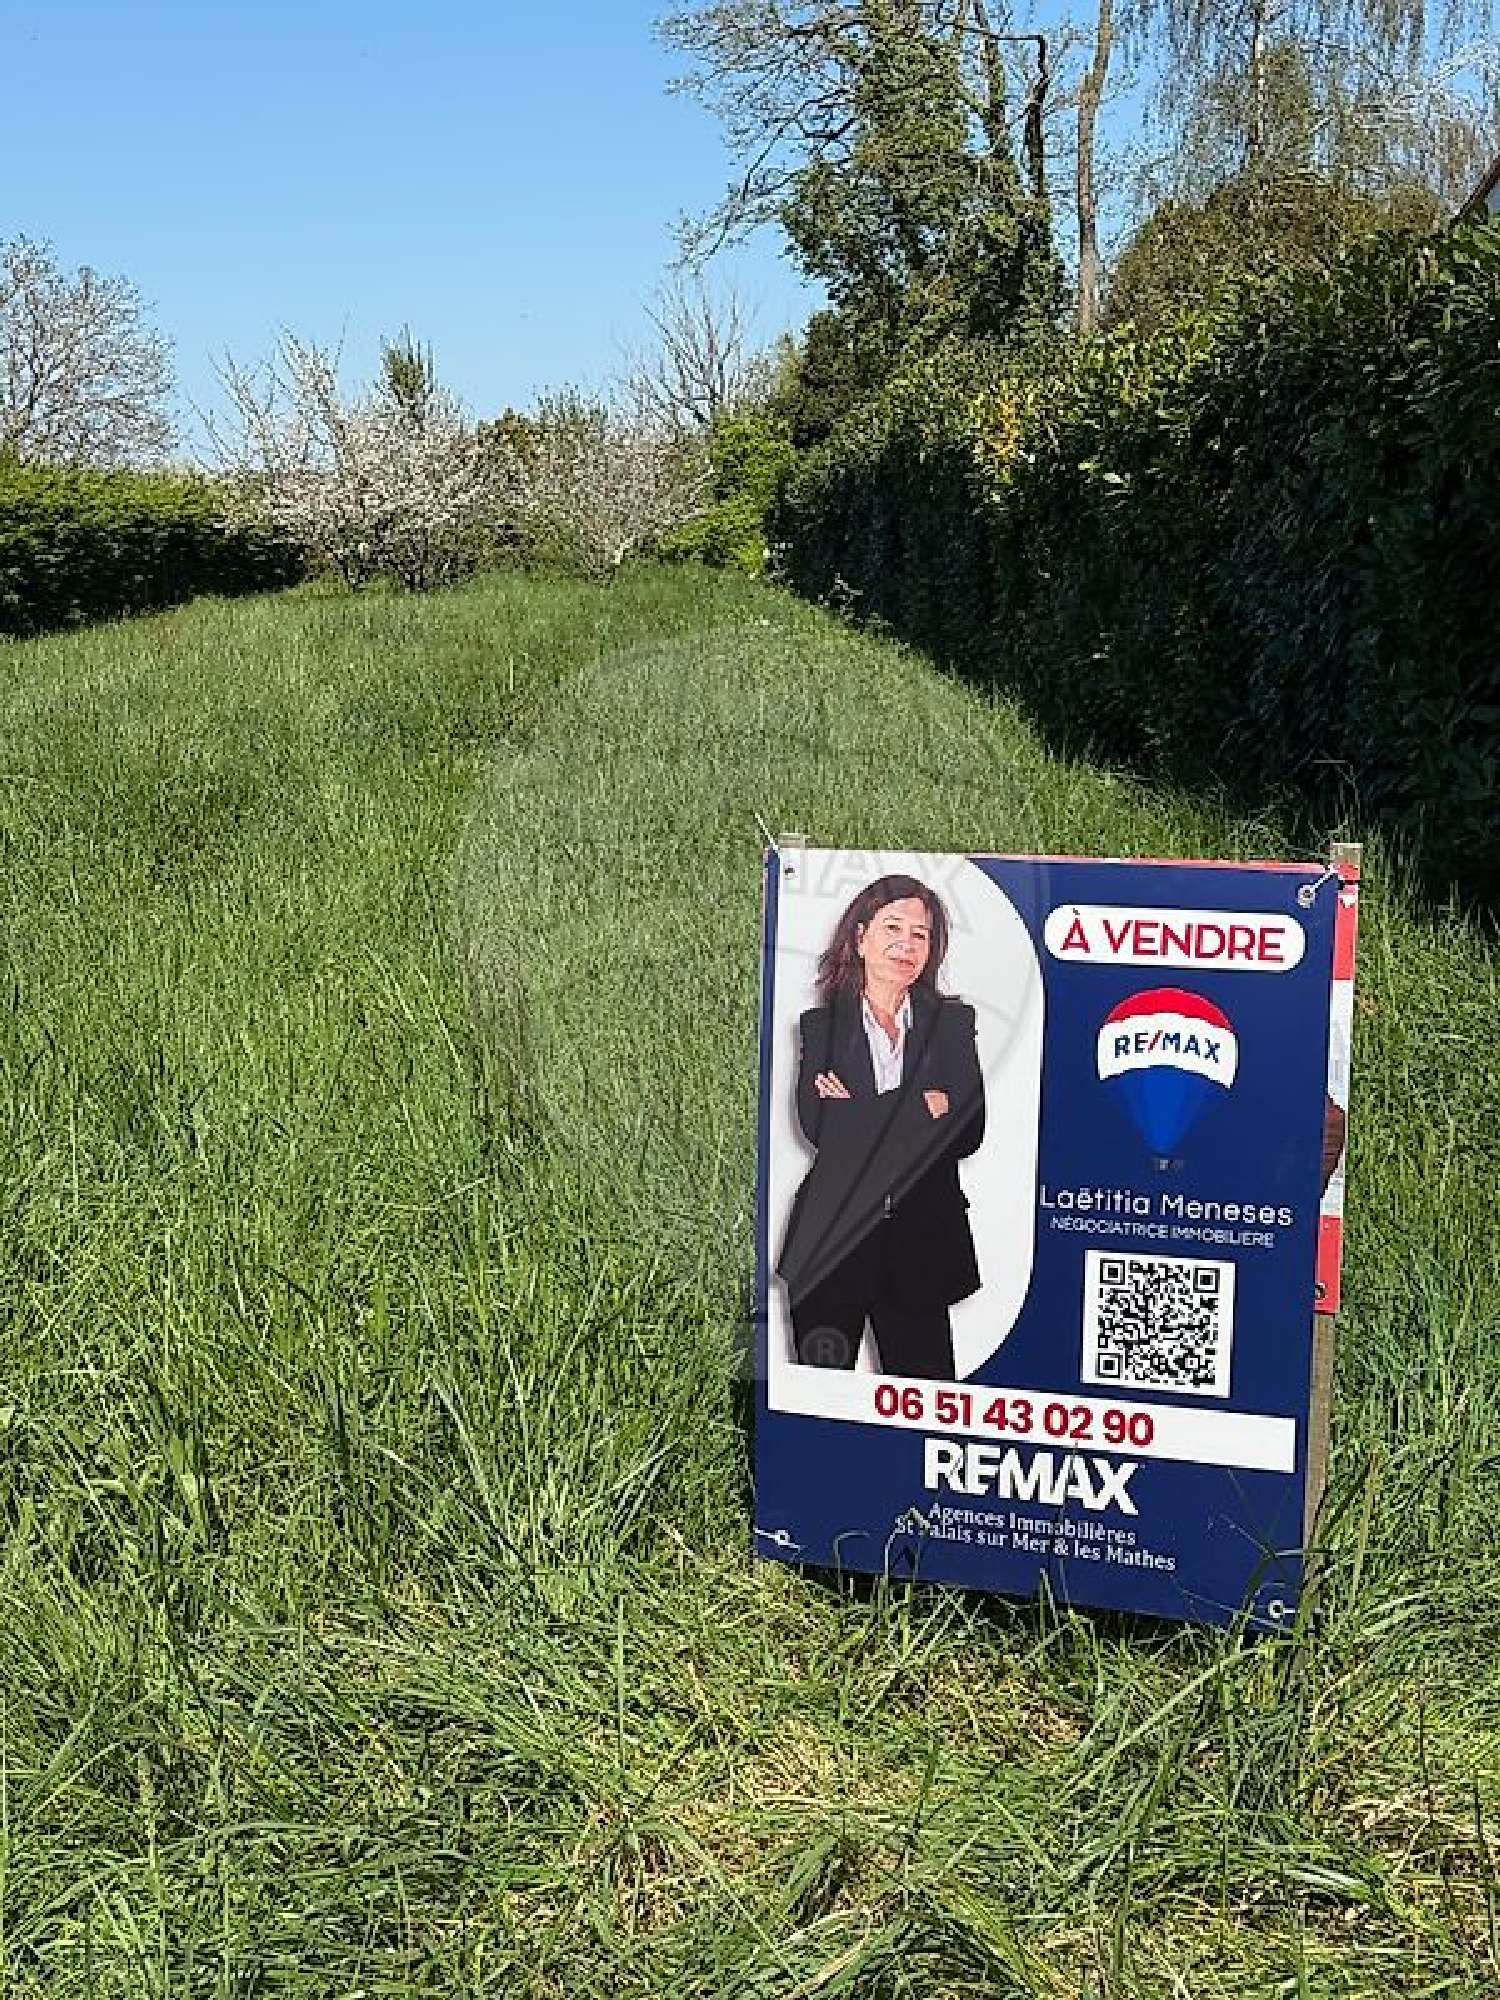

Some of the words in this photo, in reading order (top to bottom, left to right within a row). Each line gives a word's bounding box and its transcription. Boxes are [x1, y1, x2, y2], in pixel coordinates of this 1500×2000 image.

[1060, 907, 1091, 953] À
[1102, 919, 1286, 964] VENDRE
[1114, 1029, 1221, 1064] RE/MAX
[1039, 1184, 1150, 1216] Laëtitia
[1160, 1193, 1294, 1227] Meneses
[874, 1384, 925, 1421] 06
[934, 1389, 972, 1428] 51
[982, 1397, 1034, 1434] 43
[1043, 1402, 1094, 1441] 02
[1102, 1409, 1155, 1446] 90
[924, 1437, 1140, 1516] REMAX
[917, 1519, 972, 1544] alais
[975, 1528, 1008, 1547] sur
[1012, 1532, 1051, 1554] Mer
[1053, 1537, 1069, 1556] &
[1074, 1539, 1101, 1561] les
[1106, 1543, 1177, 1573] Mathes
[928, 1502, 1006, 1531] Agences
[1008, 1512, 1137, 1546] Immobilières
